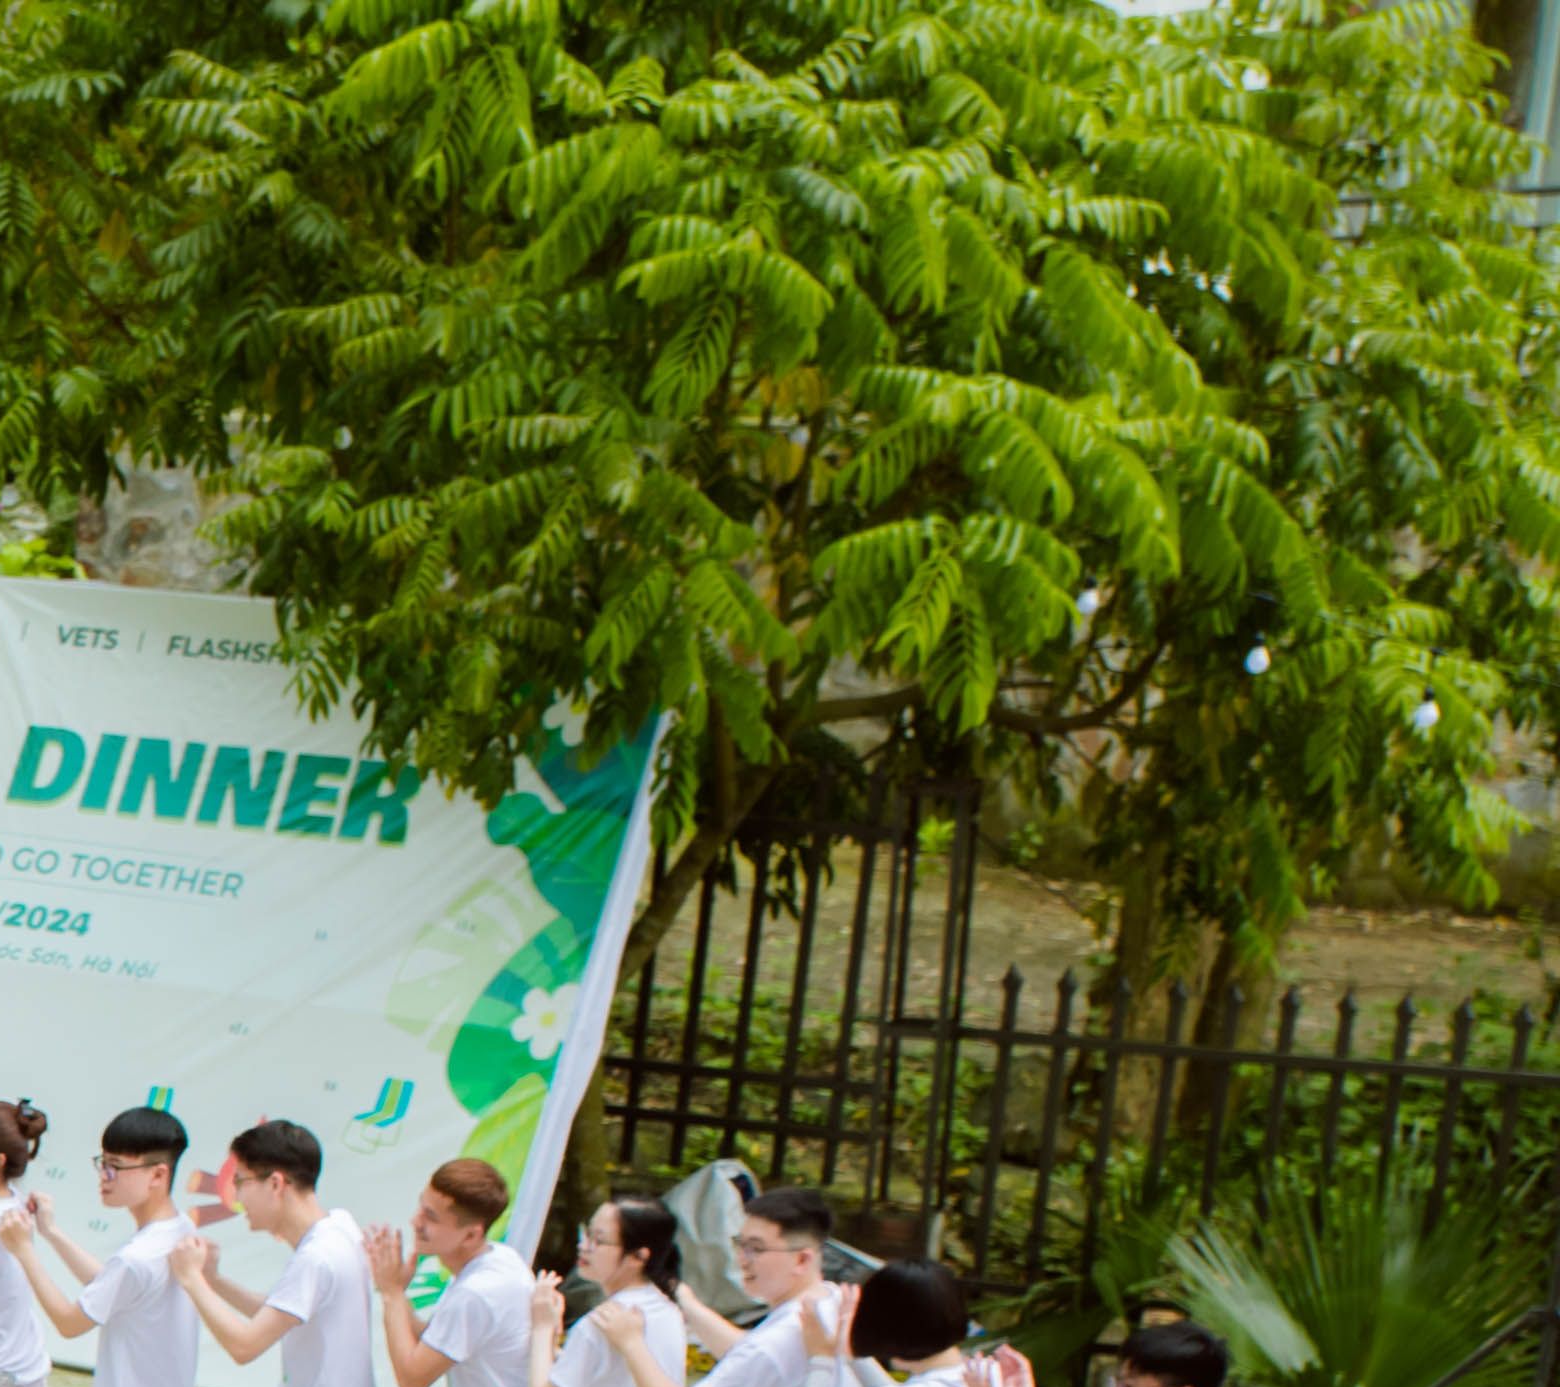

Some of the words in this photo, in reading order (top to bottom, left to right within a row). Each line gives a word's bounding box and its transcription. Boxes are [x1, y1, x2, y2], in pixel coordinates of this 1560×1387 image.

[56, 624, 120, 651] VETS
[5, 724, 421, 847] DINNER
[11, 847, 60, 876] GO
[71, 853, 245, 899] TOGETHER
